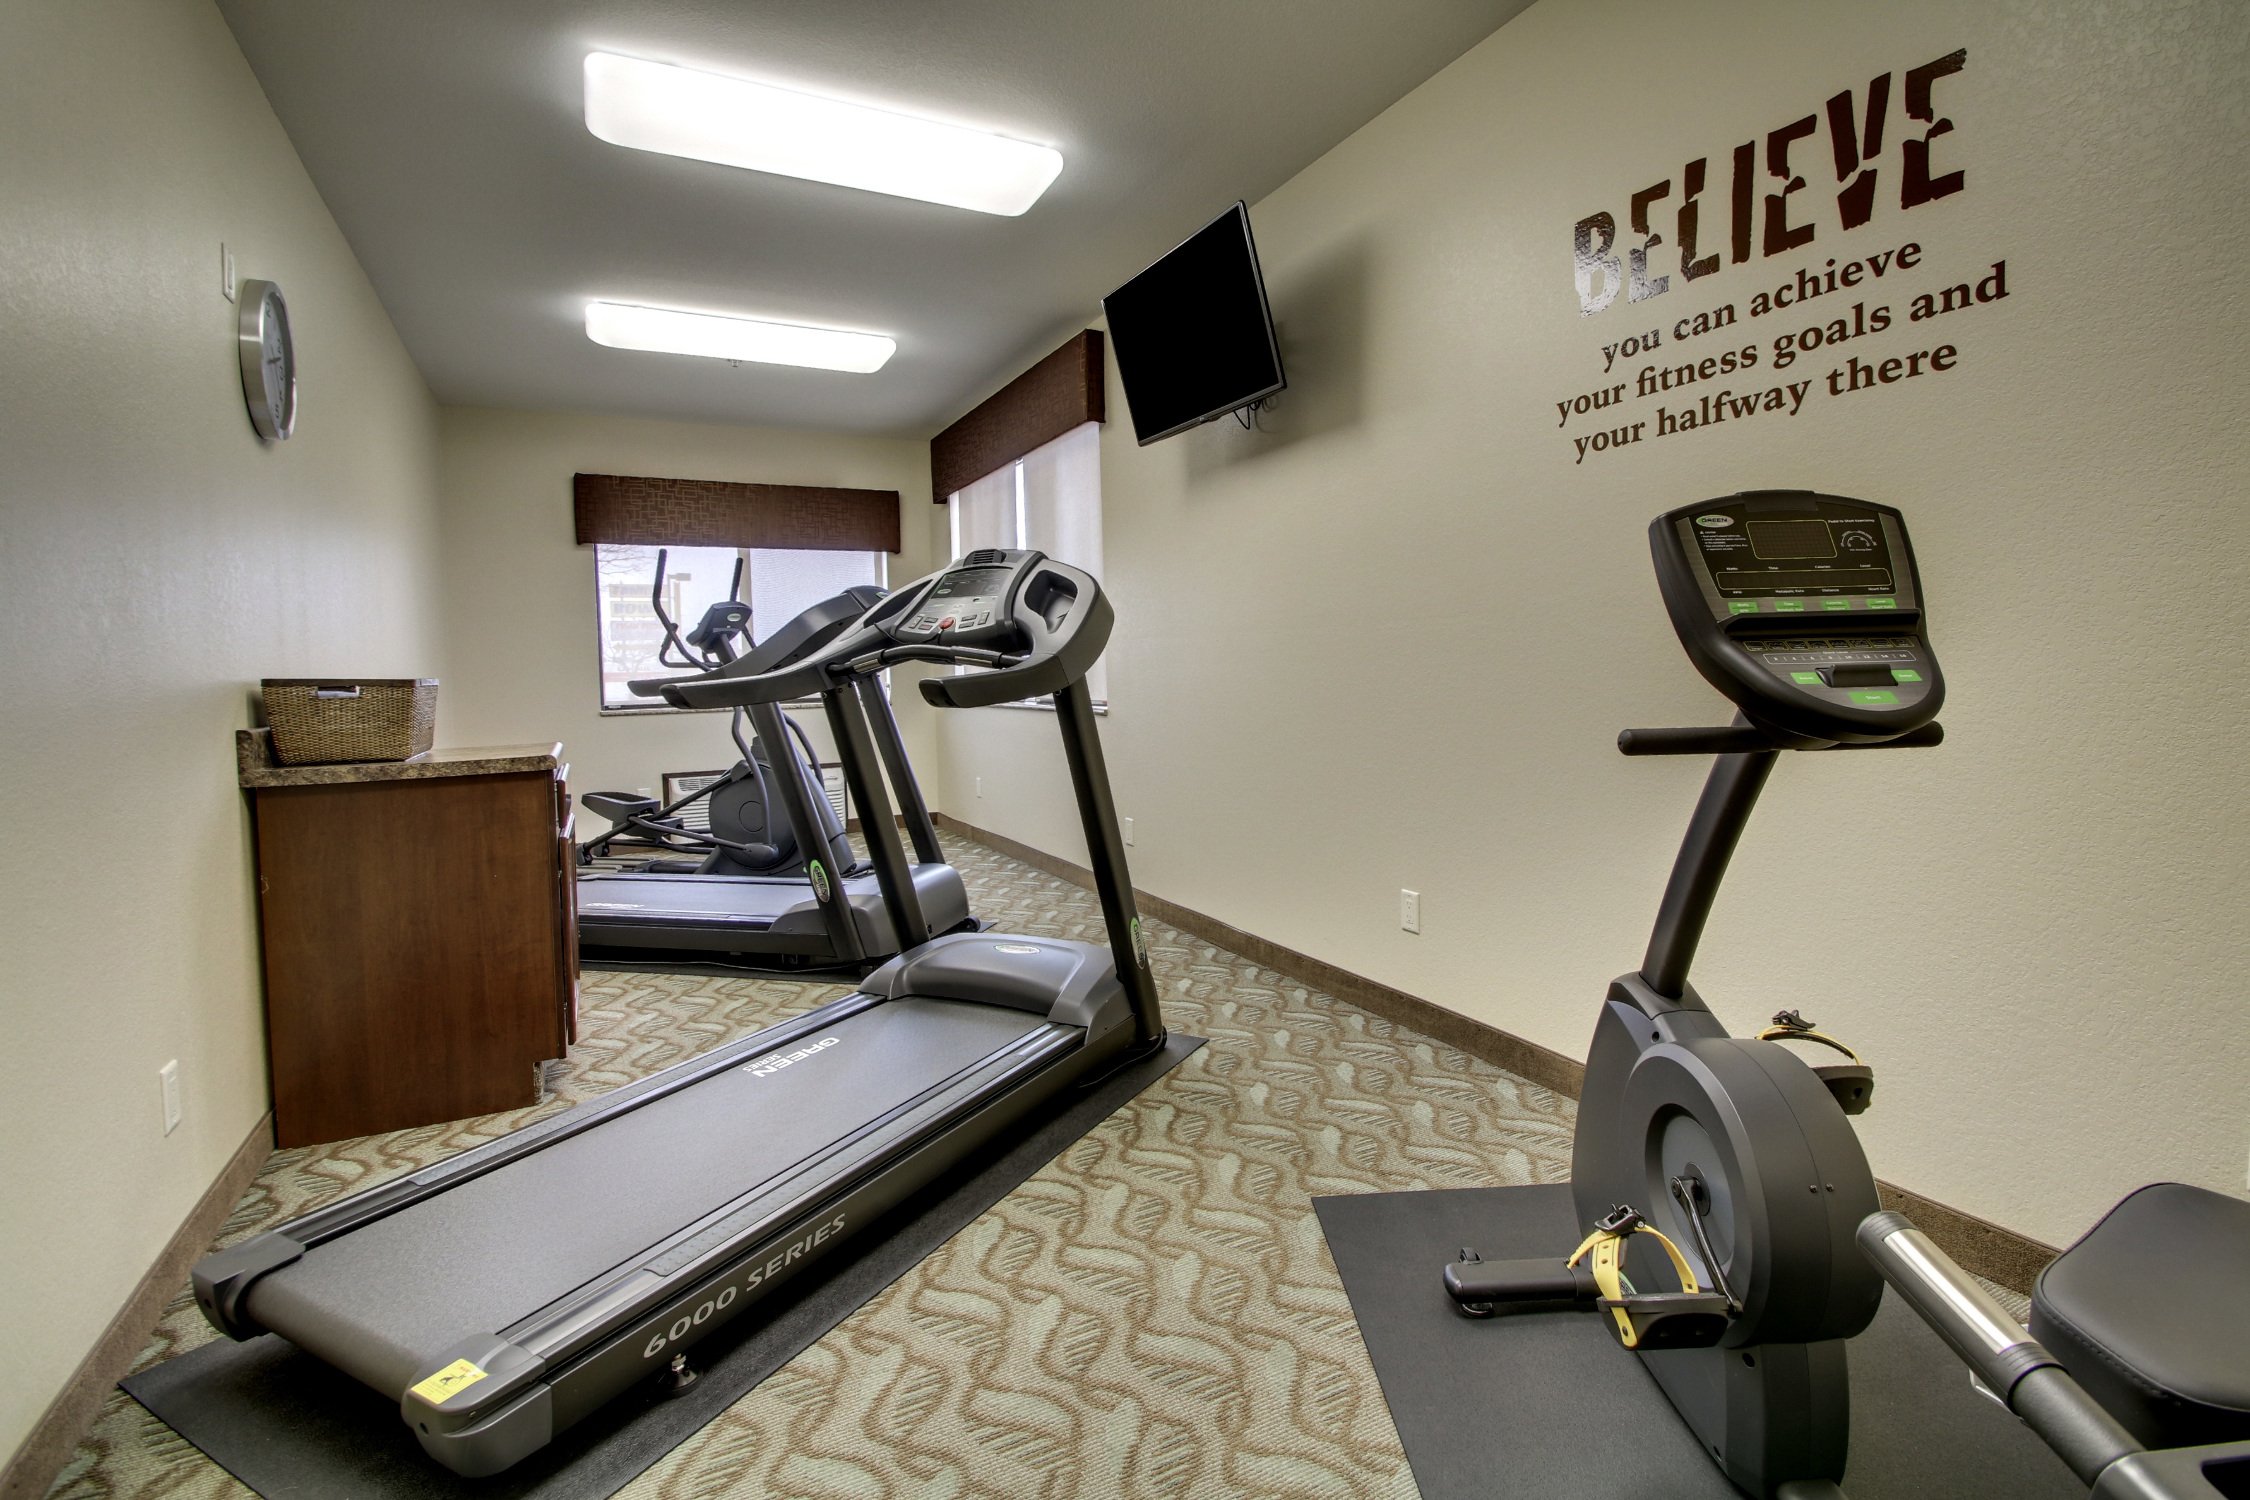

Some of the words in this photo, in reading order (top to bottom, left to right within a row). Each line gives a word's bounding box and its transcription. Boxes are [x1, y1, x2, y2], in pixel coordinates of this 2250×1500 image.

[1574, 47, 1968, 319] BELIEVE
[1556, 383, 1627, 428] your
[1636, 345, 1759, 398] fitness
[1773, 302, 1892, 369] goals
[1910, 260, 2010, 322] and
[1601, 329, 1662, 373] you
[1673, 303, 1738, 341] can
[1750, 242, 1922, 317] achieve
[1573, 421, 1646, 464] your
[1656, 380, 1812, 437] halfway
[1826, 344, 1958, 396] there
[742, 1053, 782, 1073] SERIES
[751, 1036, 841, 1078] GREEN
[642, 1285, 737, 1359] 6000
[746, 1212, 846, 1292] SERIES
